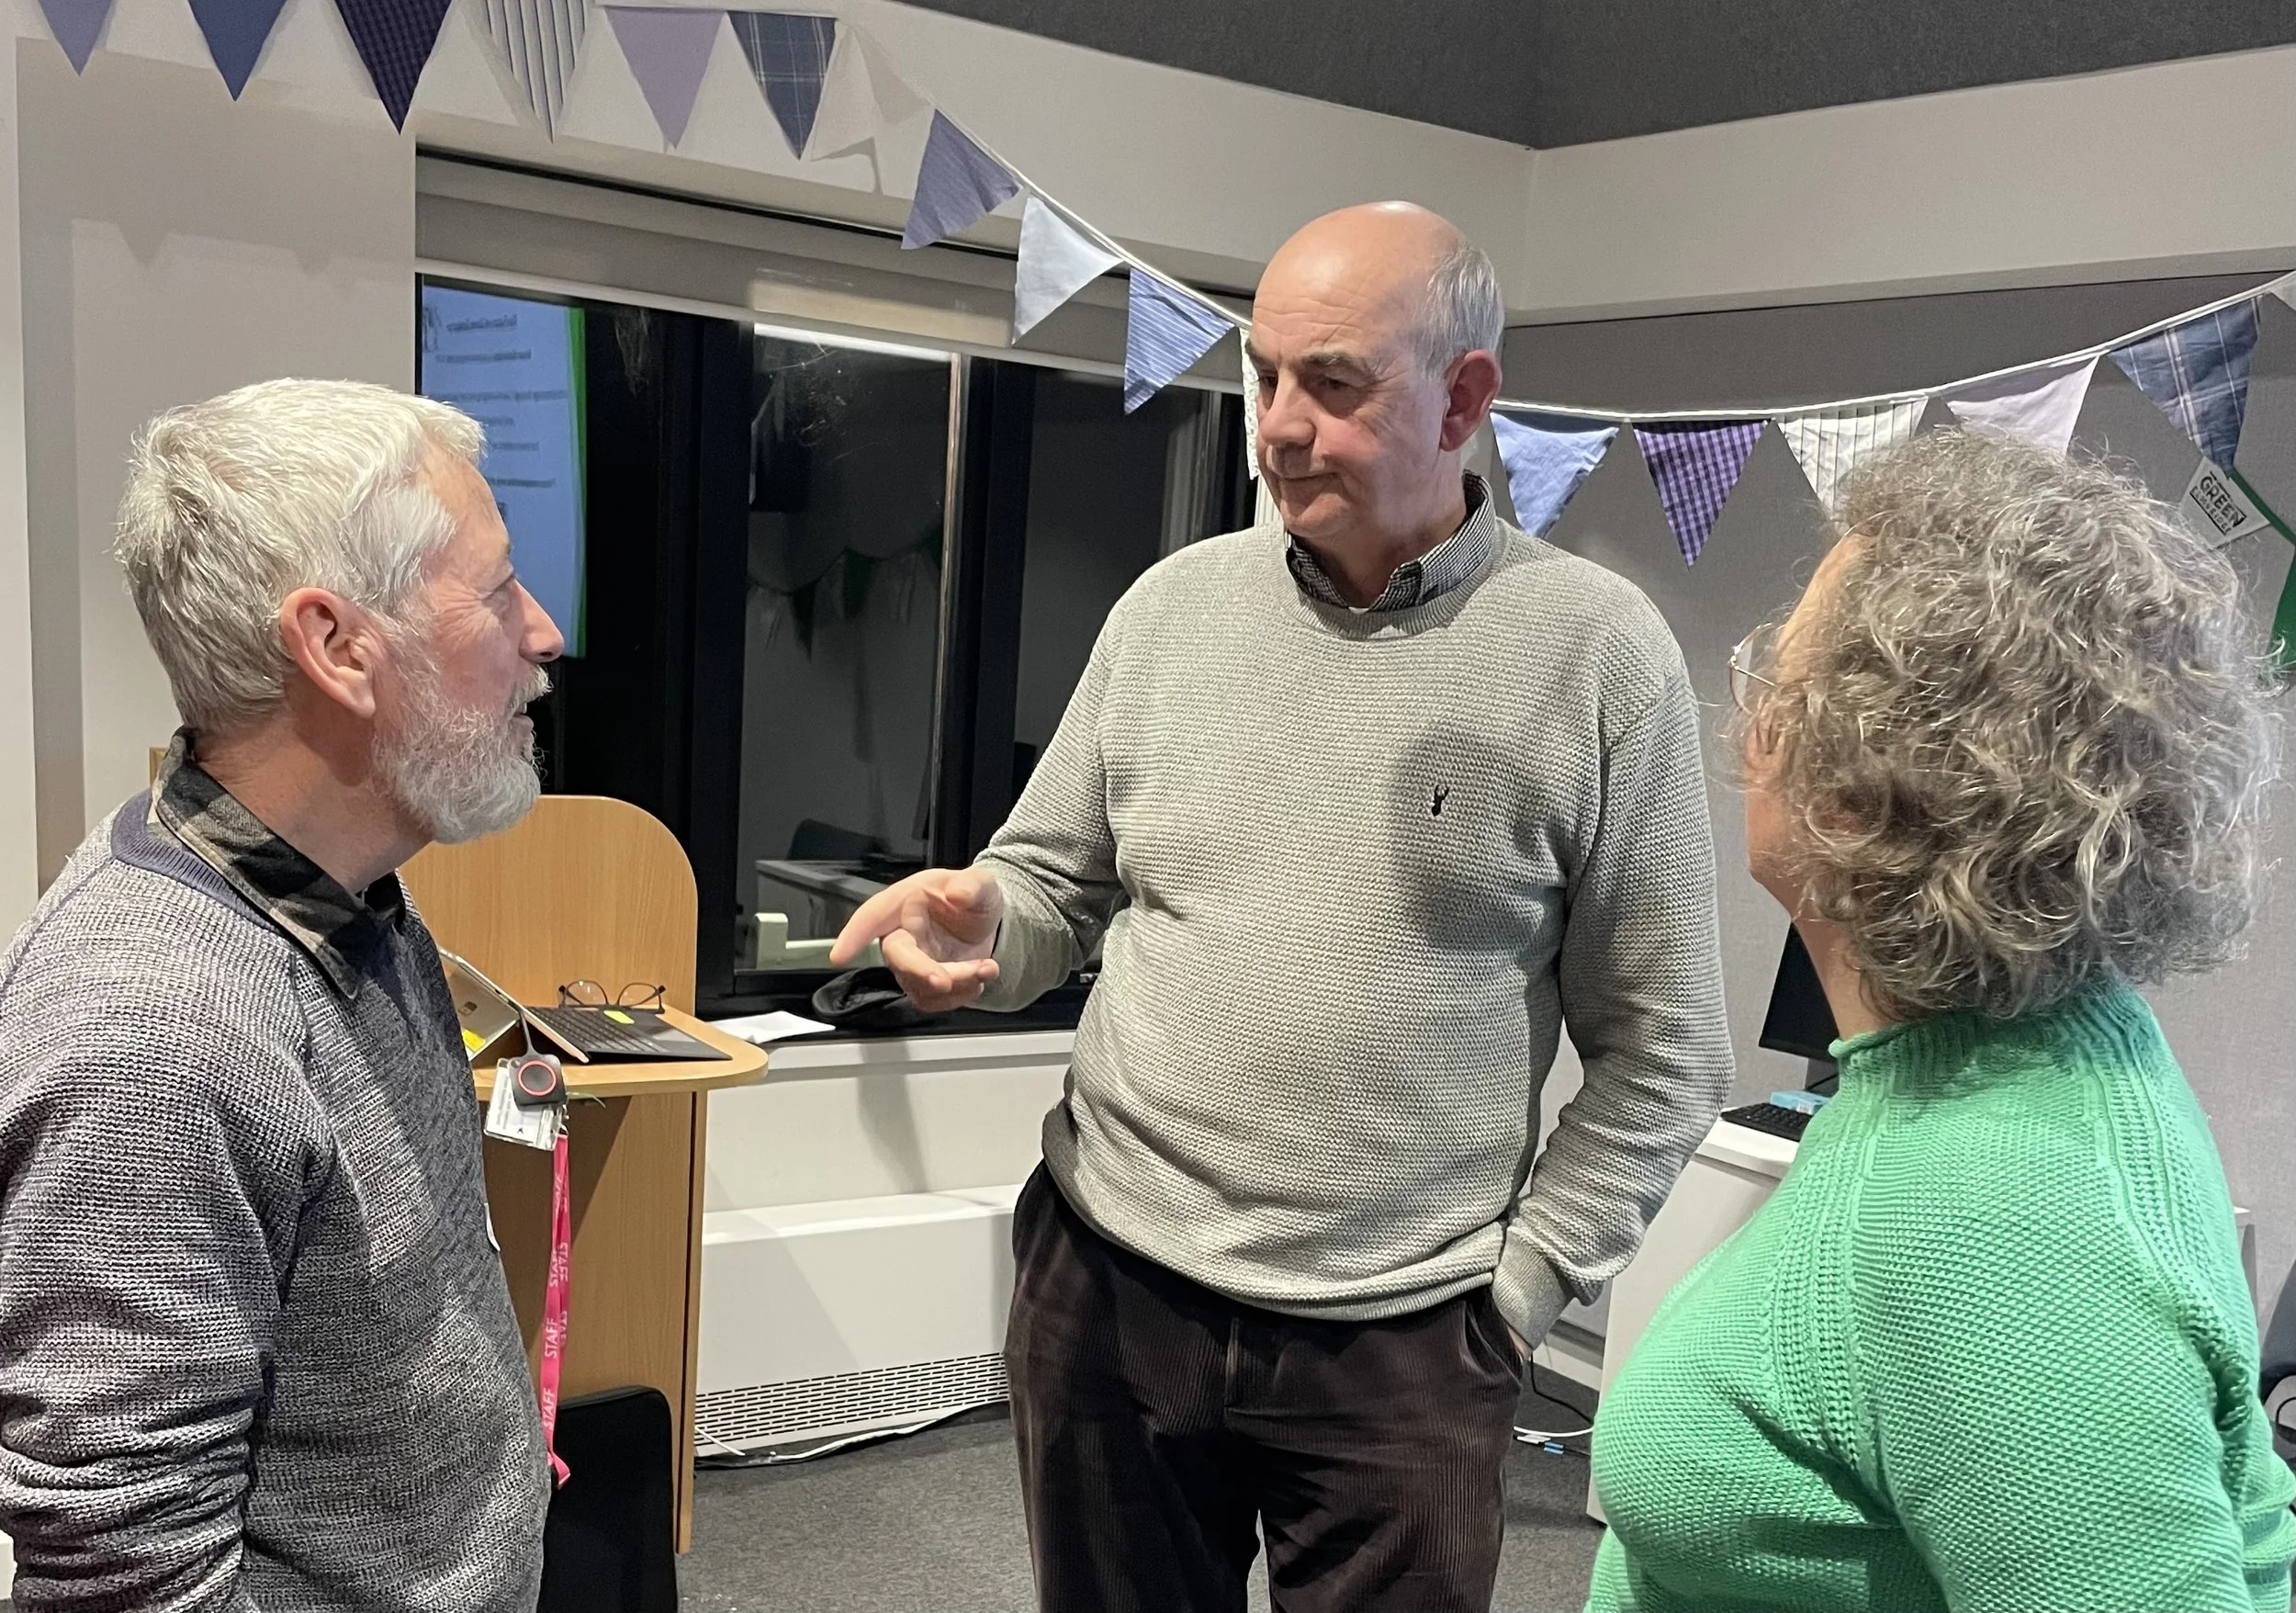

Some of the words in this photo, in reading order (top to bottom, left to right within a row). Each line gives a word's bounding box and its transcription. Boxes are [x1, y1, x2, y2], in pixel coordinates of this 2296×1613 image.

[2200, 476, 2245, 527] GREEN
[549, 1248, 558, 1287] STA
[557, 1242, 568, 1282] STAFF
[544, 1316, 557, 1359] STAFF
[543, 1386, 555, 1430] STAFF
